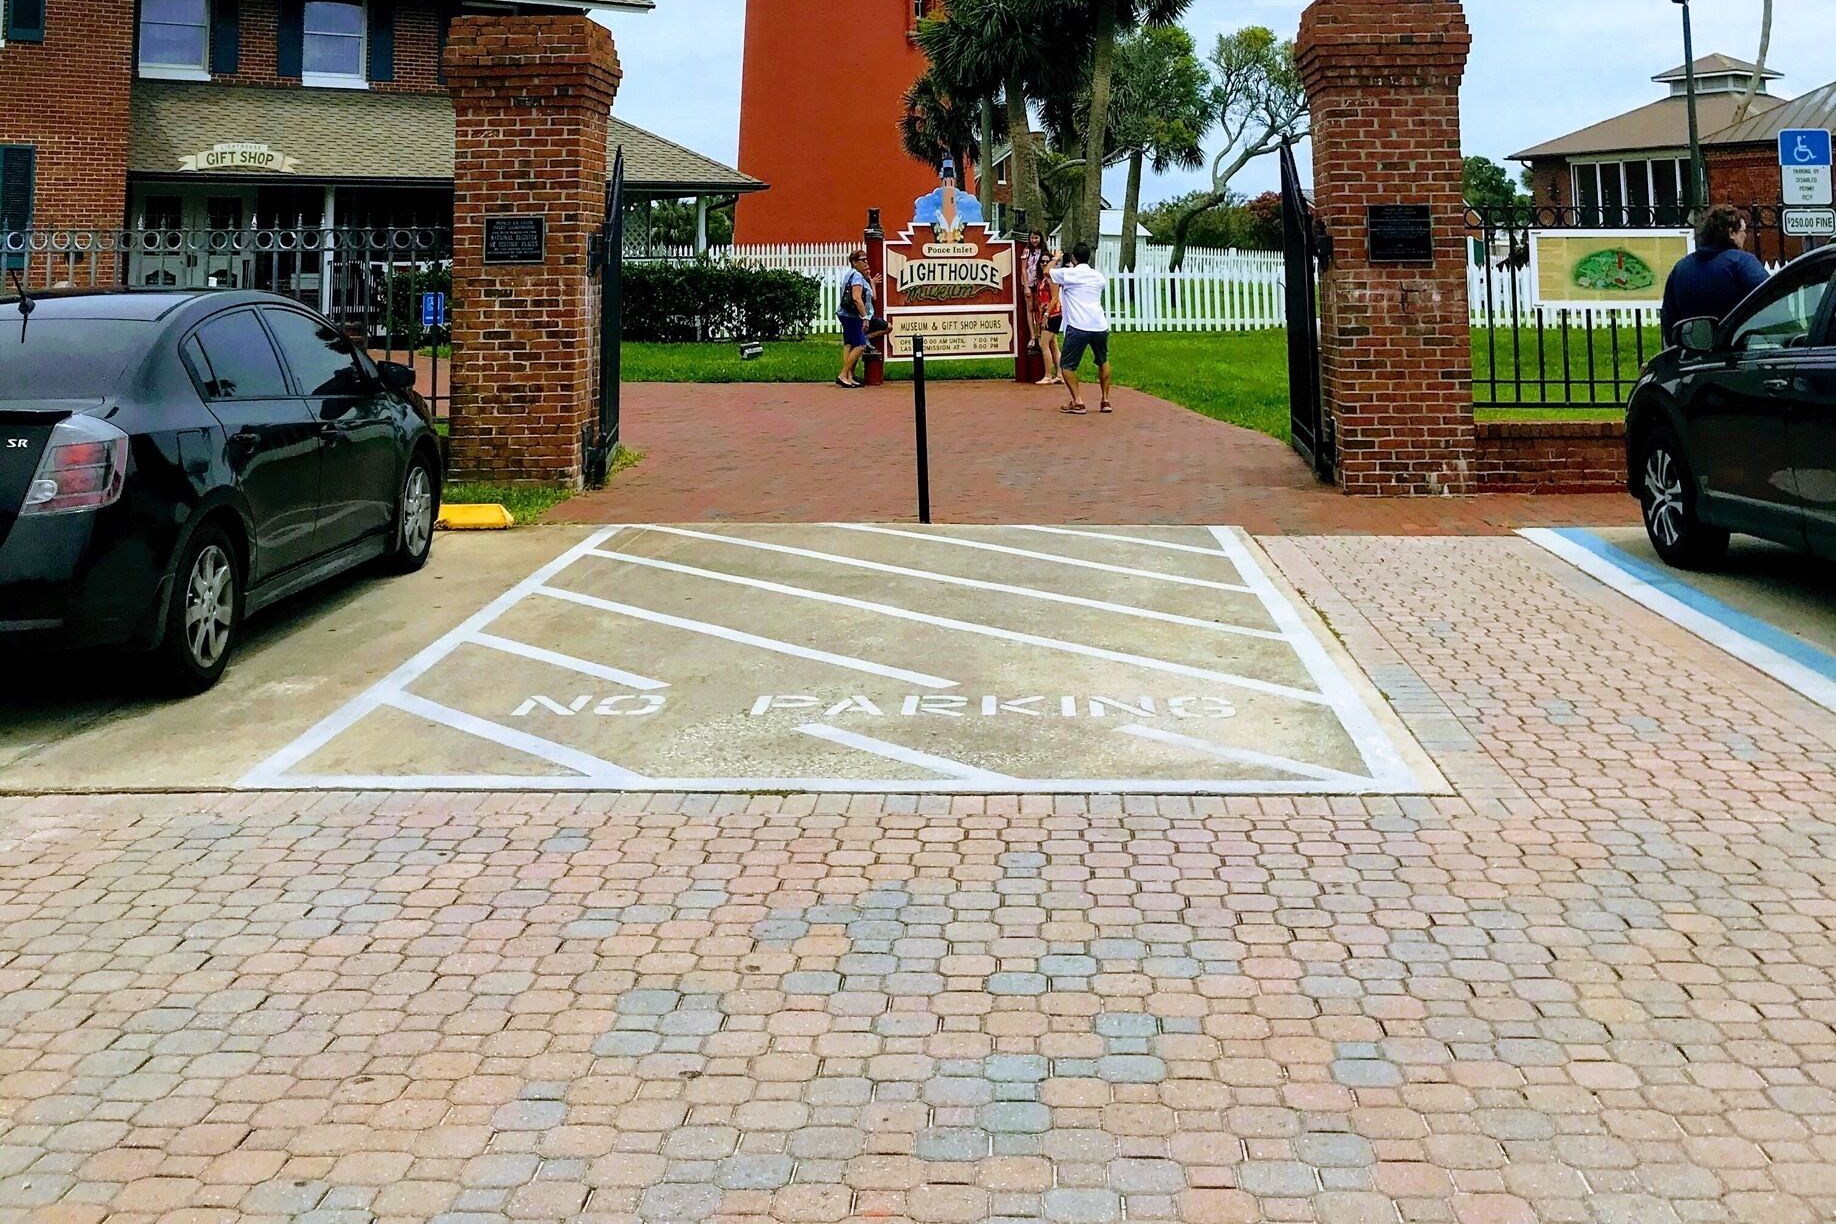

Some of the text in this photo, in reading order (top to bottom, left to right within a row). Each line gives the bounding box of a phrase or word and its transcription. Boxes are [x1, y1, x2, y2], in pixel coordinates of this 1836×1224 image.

[206, 151, 274, 166] GIFT SHOP
[1788, 217, 1833, 228] $250.00 FINE
[900, 263, 1000, 288] LIGHTHOUSE
[901, 320, 1001, 331] MUSEUM & GIFT SHOP HOURS
[6, 438, 28, 448] SR
[510, 694, 1238, 719] NO PARKING
